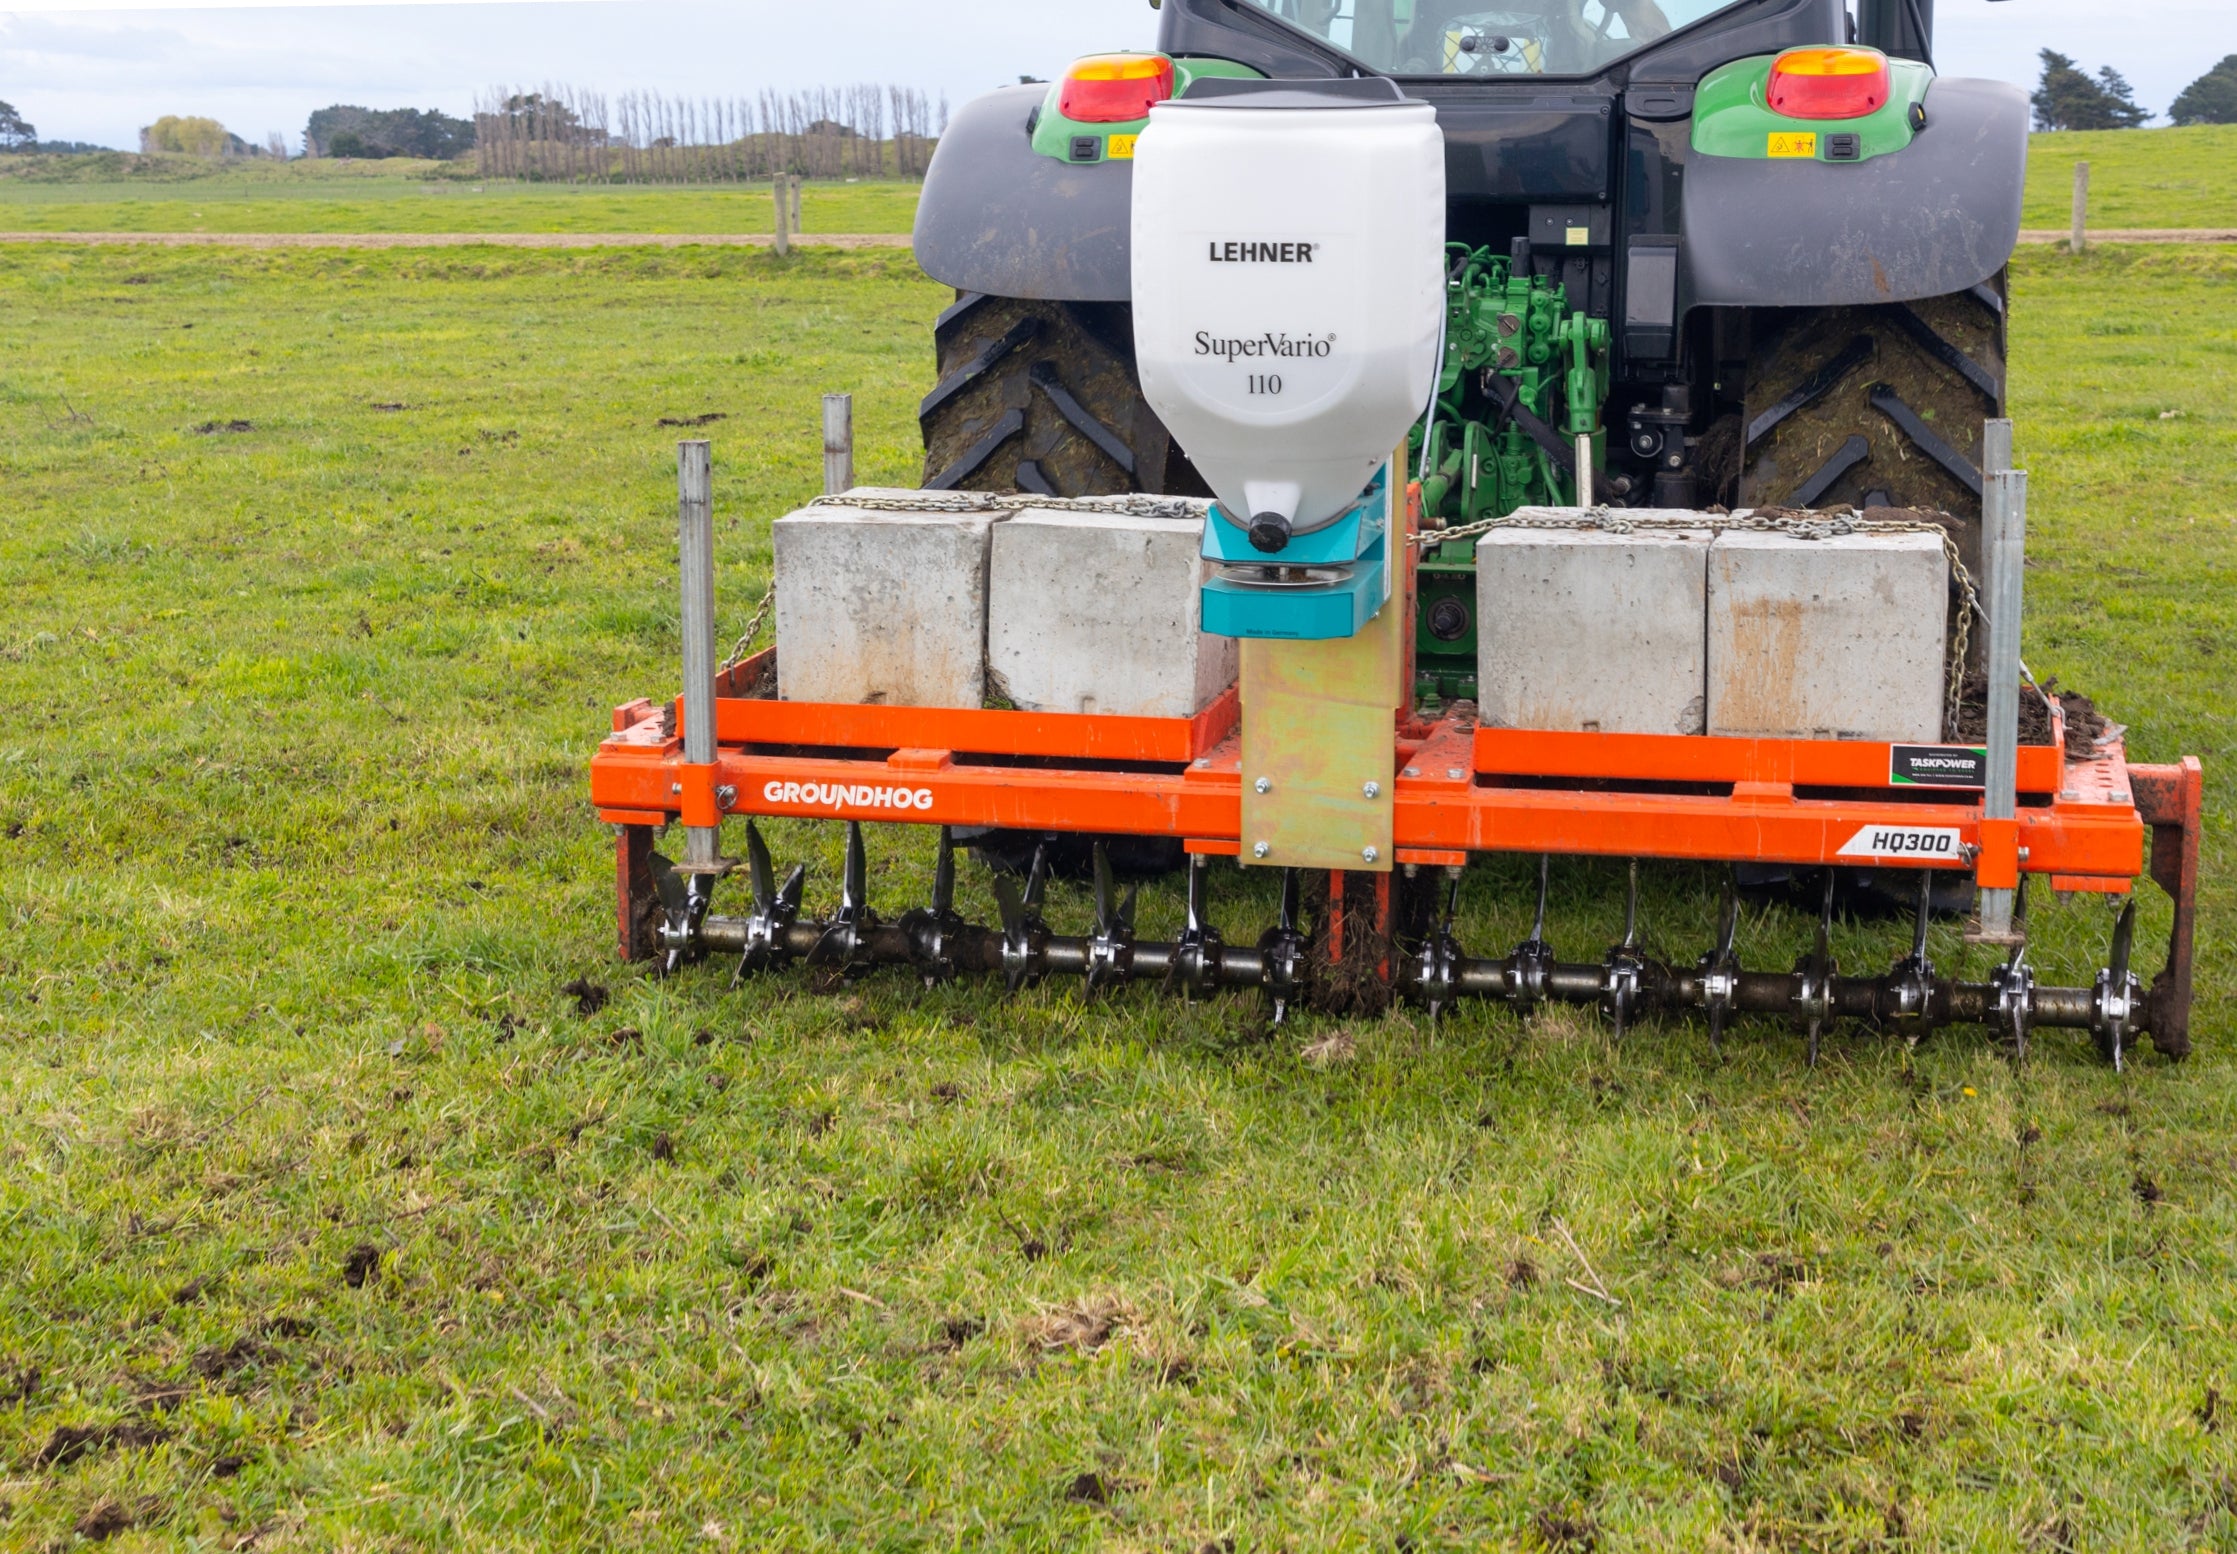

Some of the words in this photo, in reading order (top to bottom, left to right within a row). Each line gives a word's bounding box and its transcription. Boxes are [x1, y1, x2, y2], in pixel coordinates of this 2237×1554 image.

[1248, 374, 1283, 395] 110
[1909, 757, 1976, 769] TASKPOWER
[763, 780, 933, 811] GROUNDHOG
[1872, 831, 1951, 853] HQ300
